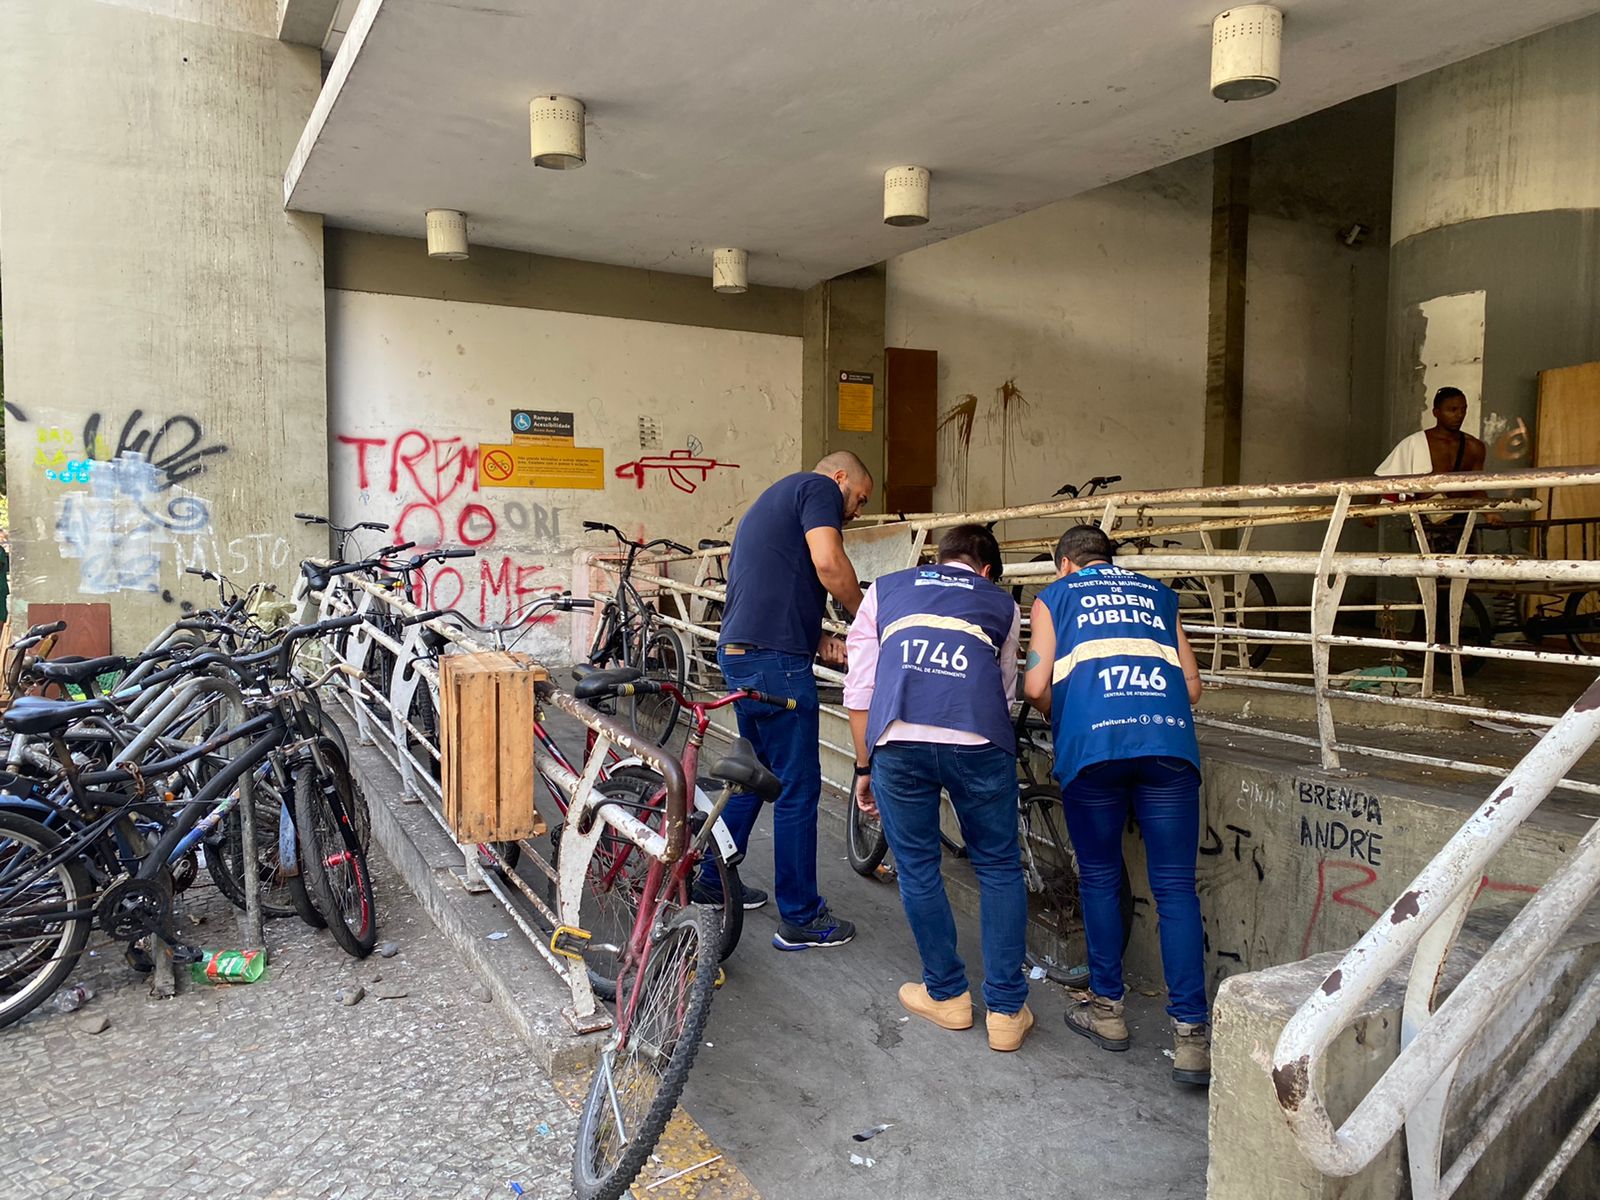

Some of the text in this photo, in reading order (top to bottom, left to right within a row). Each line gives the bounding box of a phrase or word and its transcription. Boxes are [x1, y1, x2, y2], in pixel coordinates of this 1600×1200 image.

[533, 421, 571, 429] Acessibilidade
[1068, 580, 1159, 592] SECRETARIA MUNICIPAL
[1080, 594, 1155, 610] ORDEM
[1077, 608, 1166, 630] PÚBLICA
[900, 639, 969, 671] 1746
[902, 664, 923, 673] CENTRAL
[932, 668, 966, 679] ATENDIMENTO
[1098, 665, 1167, 691] 1746
[1091, 716, 1138, 730] prefeitura.rio
[1299, 782, 1382, 825] BRENDA
